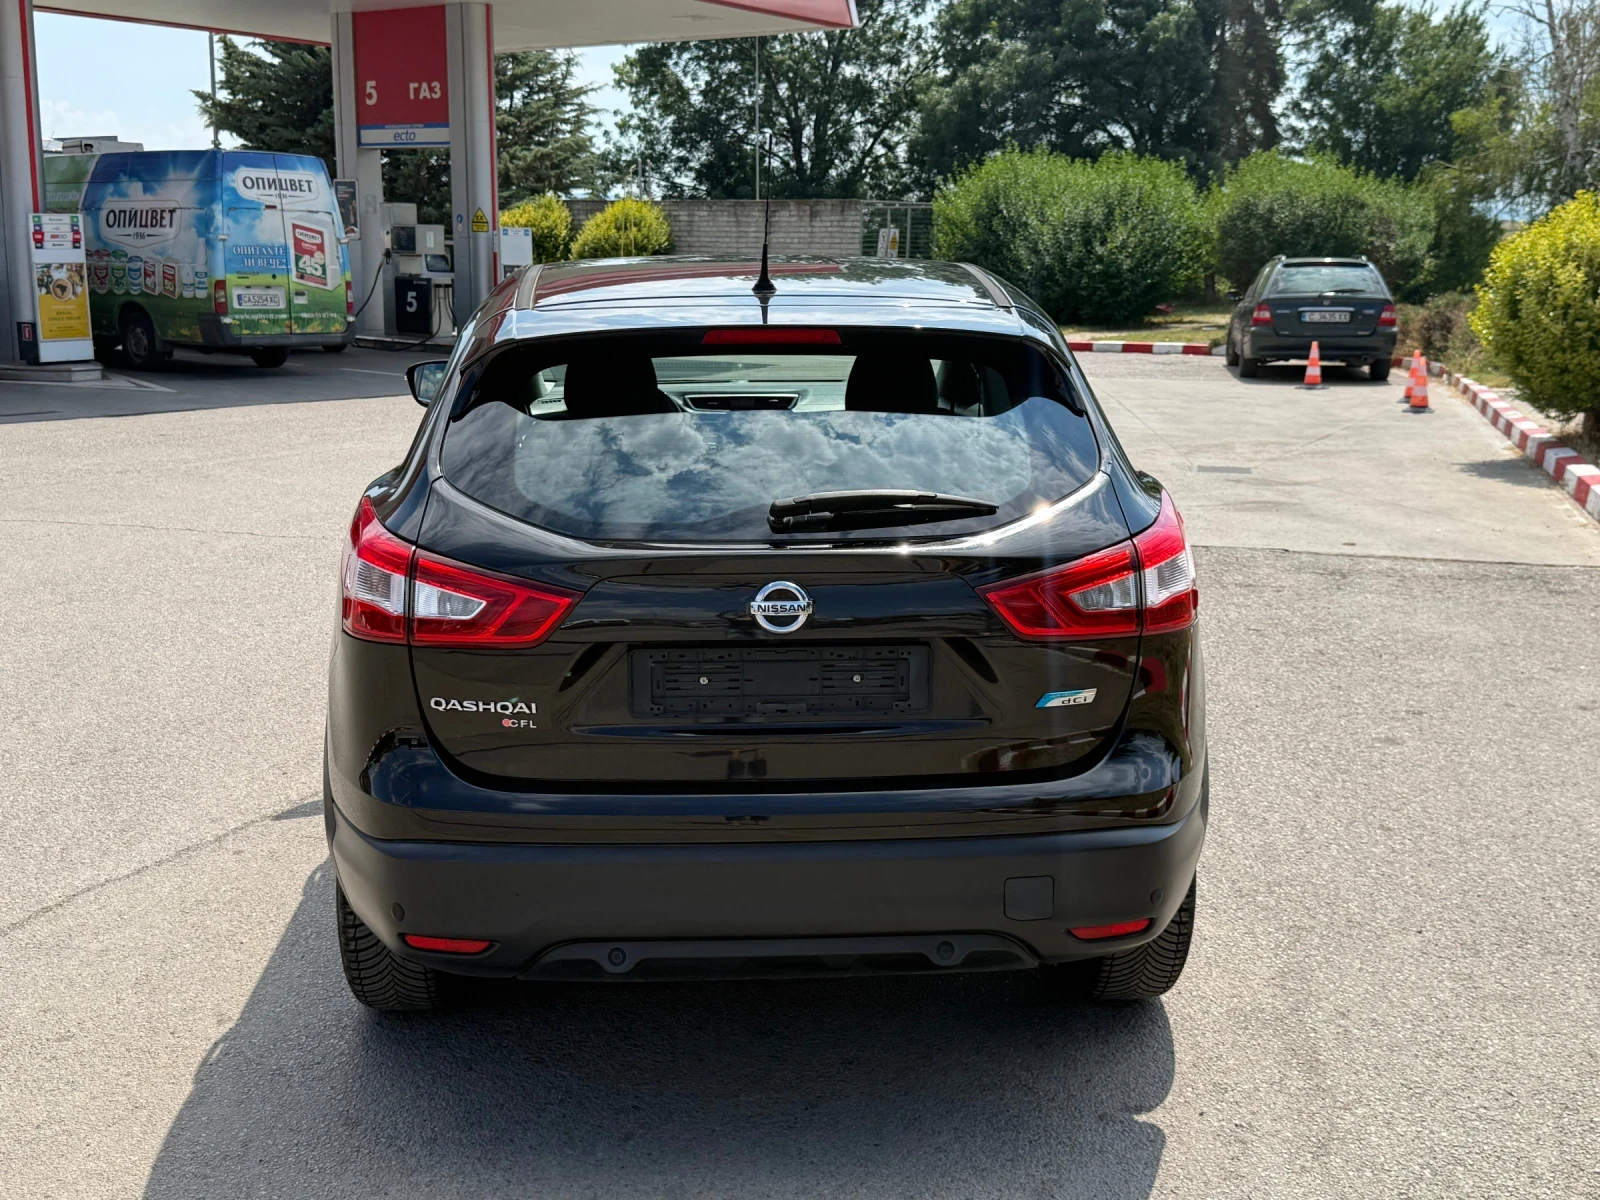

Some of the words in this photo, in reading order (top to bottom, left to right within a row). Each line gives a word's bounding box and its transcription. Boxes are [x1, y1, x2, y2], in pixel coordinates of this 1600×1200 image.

[365, 80, 378, 106] 5
[409, 81, 442, 100] ГАЗ
[393, 129, 416, 142] ecto
[242, 176, 313, 193] ОПИЦВЕТ
[132, 231, 146, 240] 1936
[232, 246, 286, 255] ОПИТАХТЕ
[241, 258, 255, 267] ЛИ
[299, 254, 323, 277] 45
[405, 291, 418, 313] 5
[757, 604, 806, 613] NISSAN
[430, 697, 537, 715] QASHQAI
[1061, 696, 1088, 705] dCi
